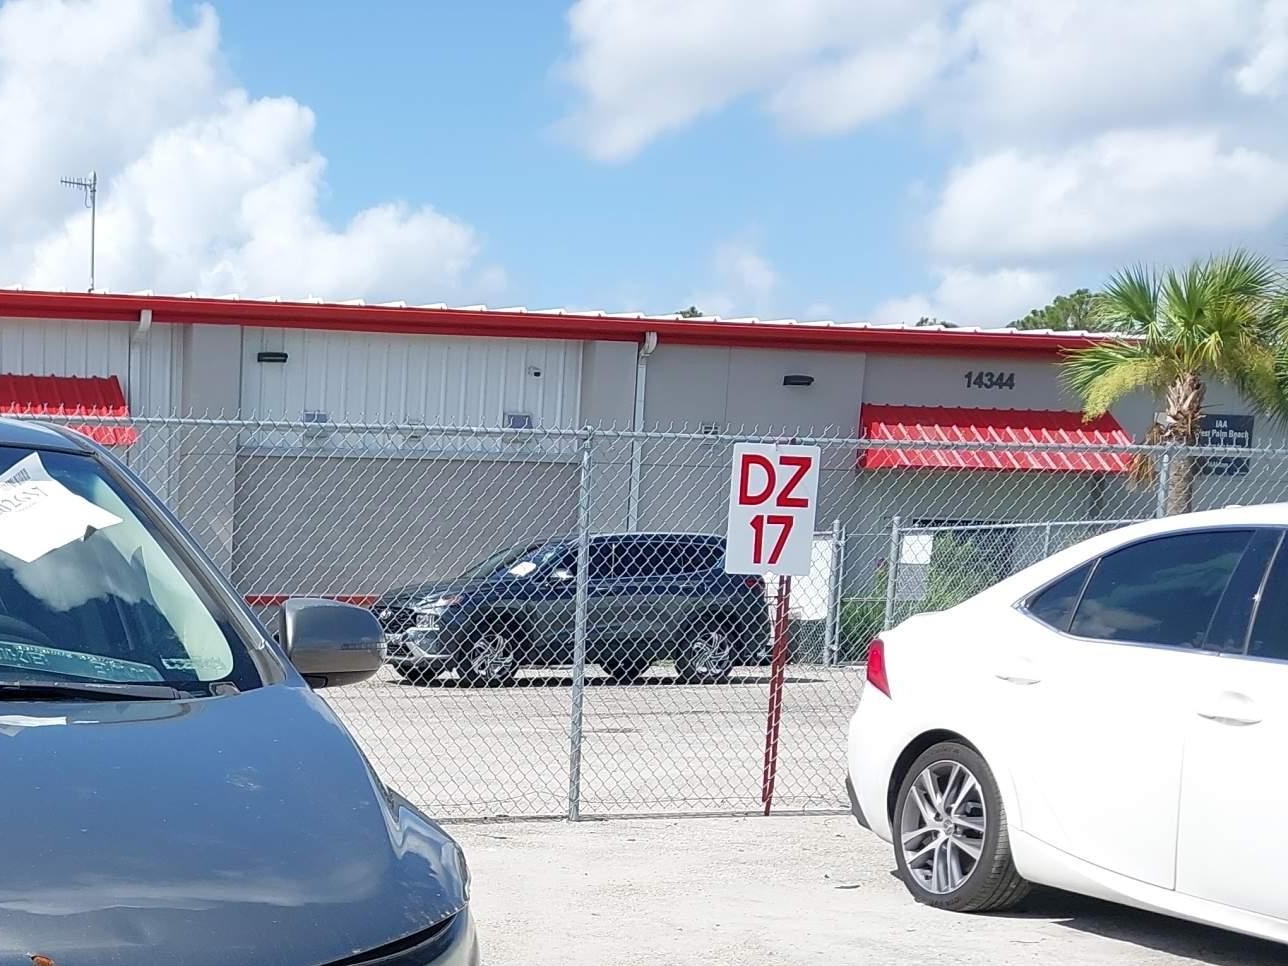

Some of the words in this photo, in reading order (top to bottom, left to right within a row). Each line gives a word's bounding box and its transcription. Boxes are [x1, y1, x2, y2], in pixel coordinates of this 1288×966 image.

[964, 371, 1015, 390] 14344
[1211, 429, 1227, 437] Palm
[1228, 430, 1249, 438] Beach
[1215, 420, 1228, 428] IAA
[739, 453, 812, 508] DZ
[750, 514, 794, 564] 17
